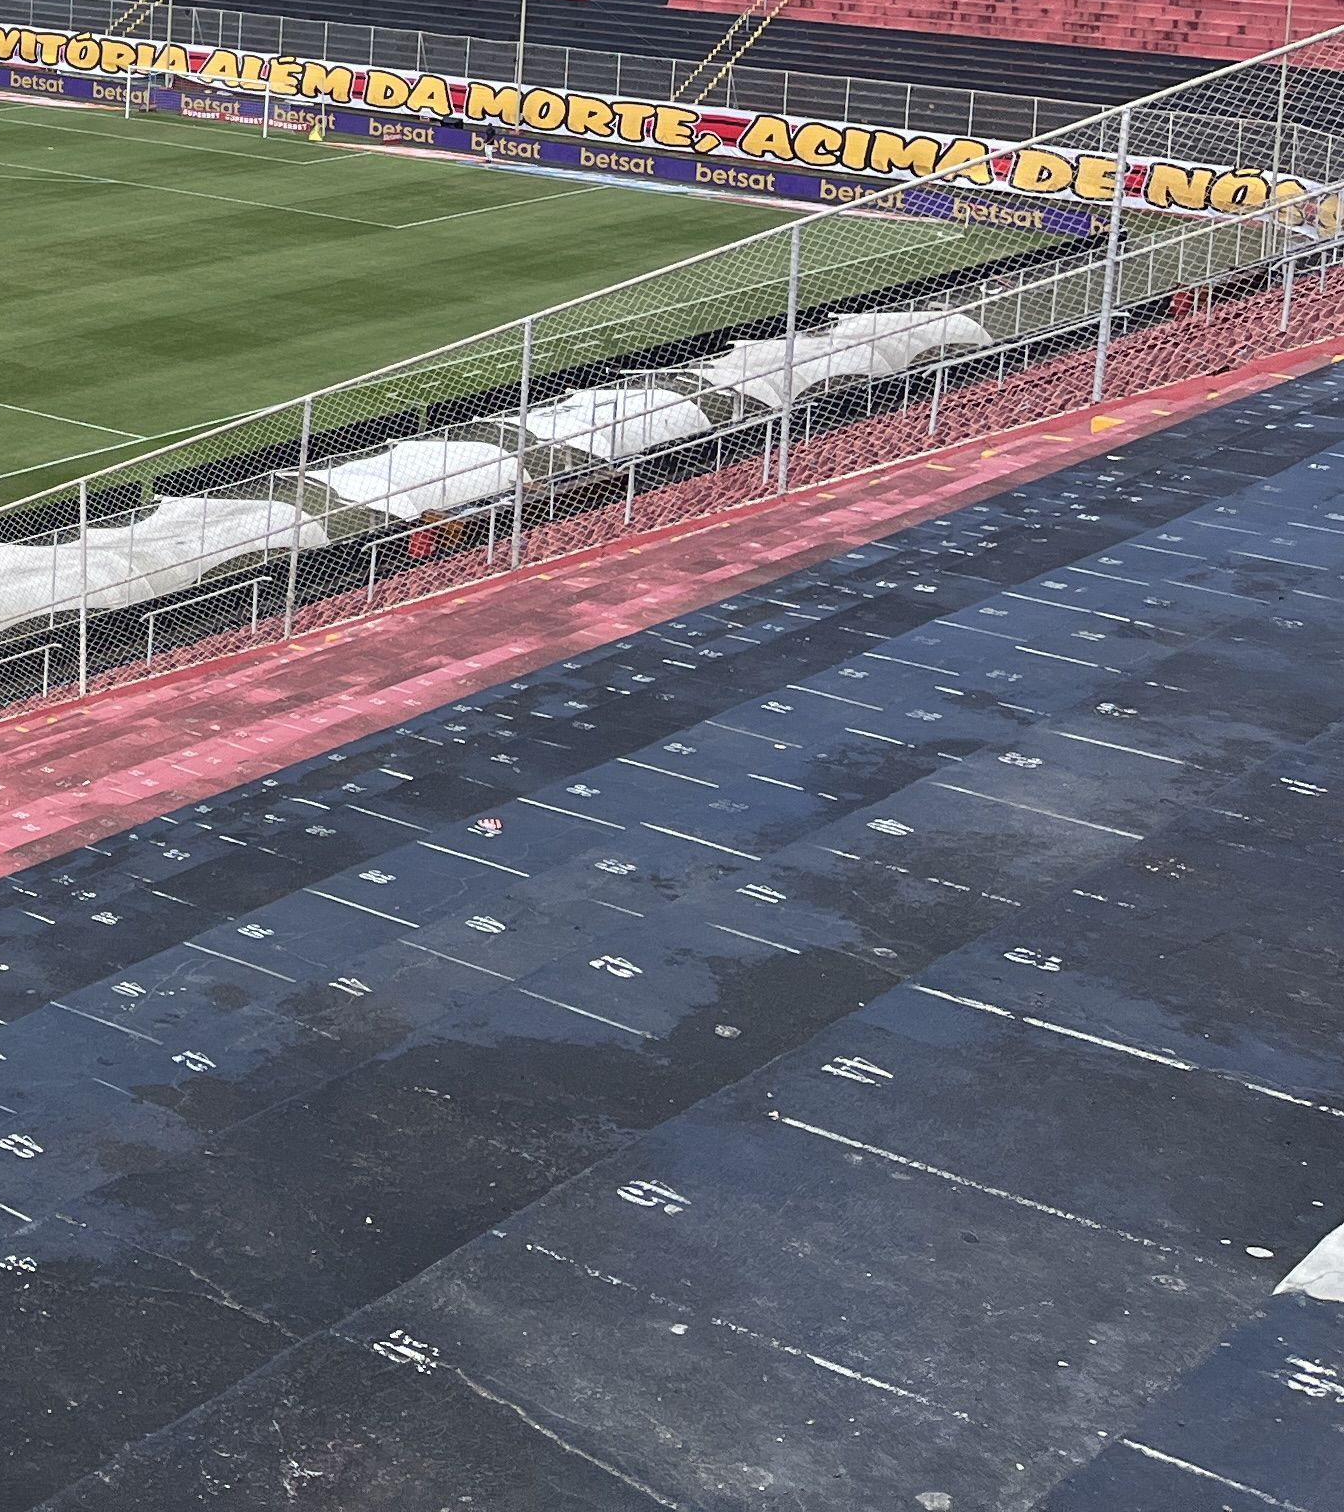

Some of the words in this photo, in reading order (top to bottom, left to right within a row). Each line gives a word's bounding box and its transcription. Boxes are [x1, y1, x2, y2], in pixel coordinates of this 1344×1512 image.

[10, 71, 64, 93] betsat
[181, 93, 240, 116] betsat
[198, 49, 354, 103] ALÉM
[364, 70, 453, 116] DA
[465, 82, 721, 154] MORTE,
[738, 115, 993, 185] ACIMA
[1009, 147, 1130, 201] DE
[274, 105, 335, 130] betsat
[580, 147, 655, 175] betsat
[696, 163, 775, 191] betsat
[589, 955, 643, 978] 42
[111, 981, 147, 998] 40
[328, 977, 373, 997] 41
[171, 1050, 217, 1072] 42
